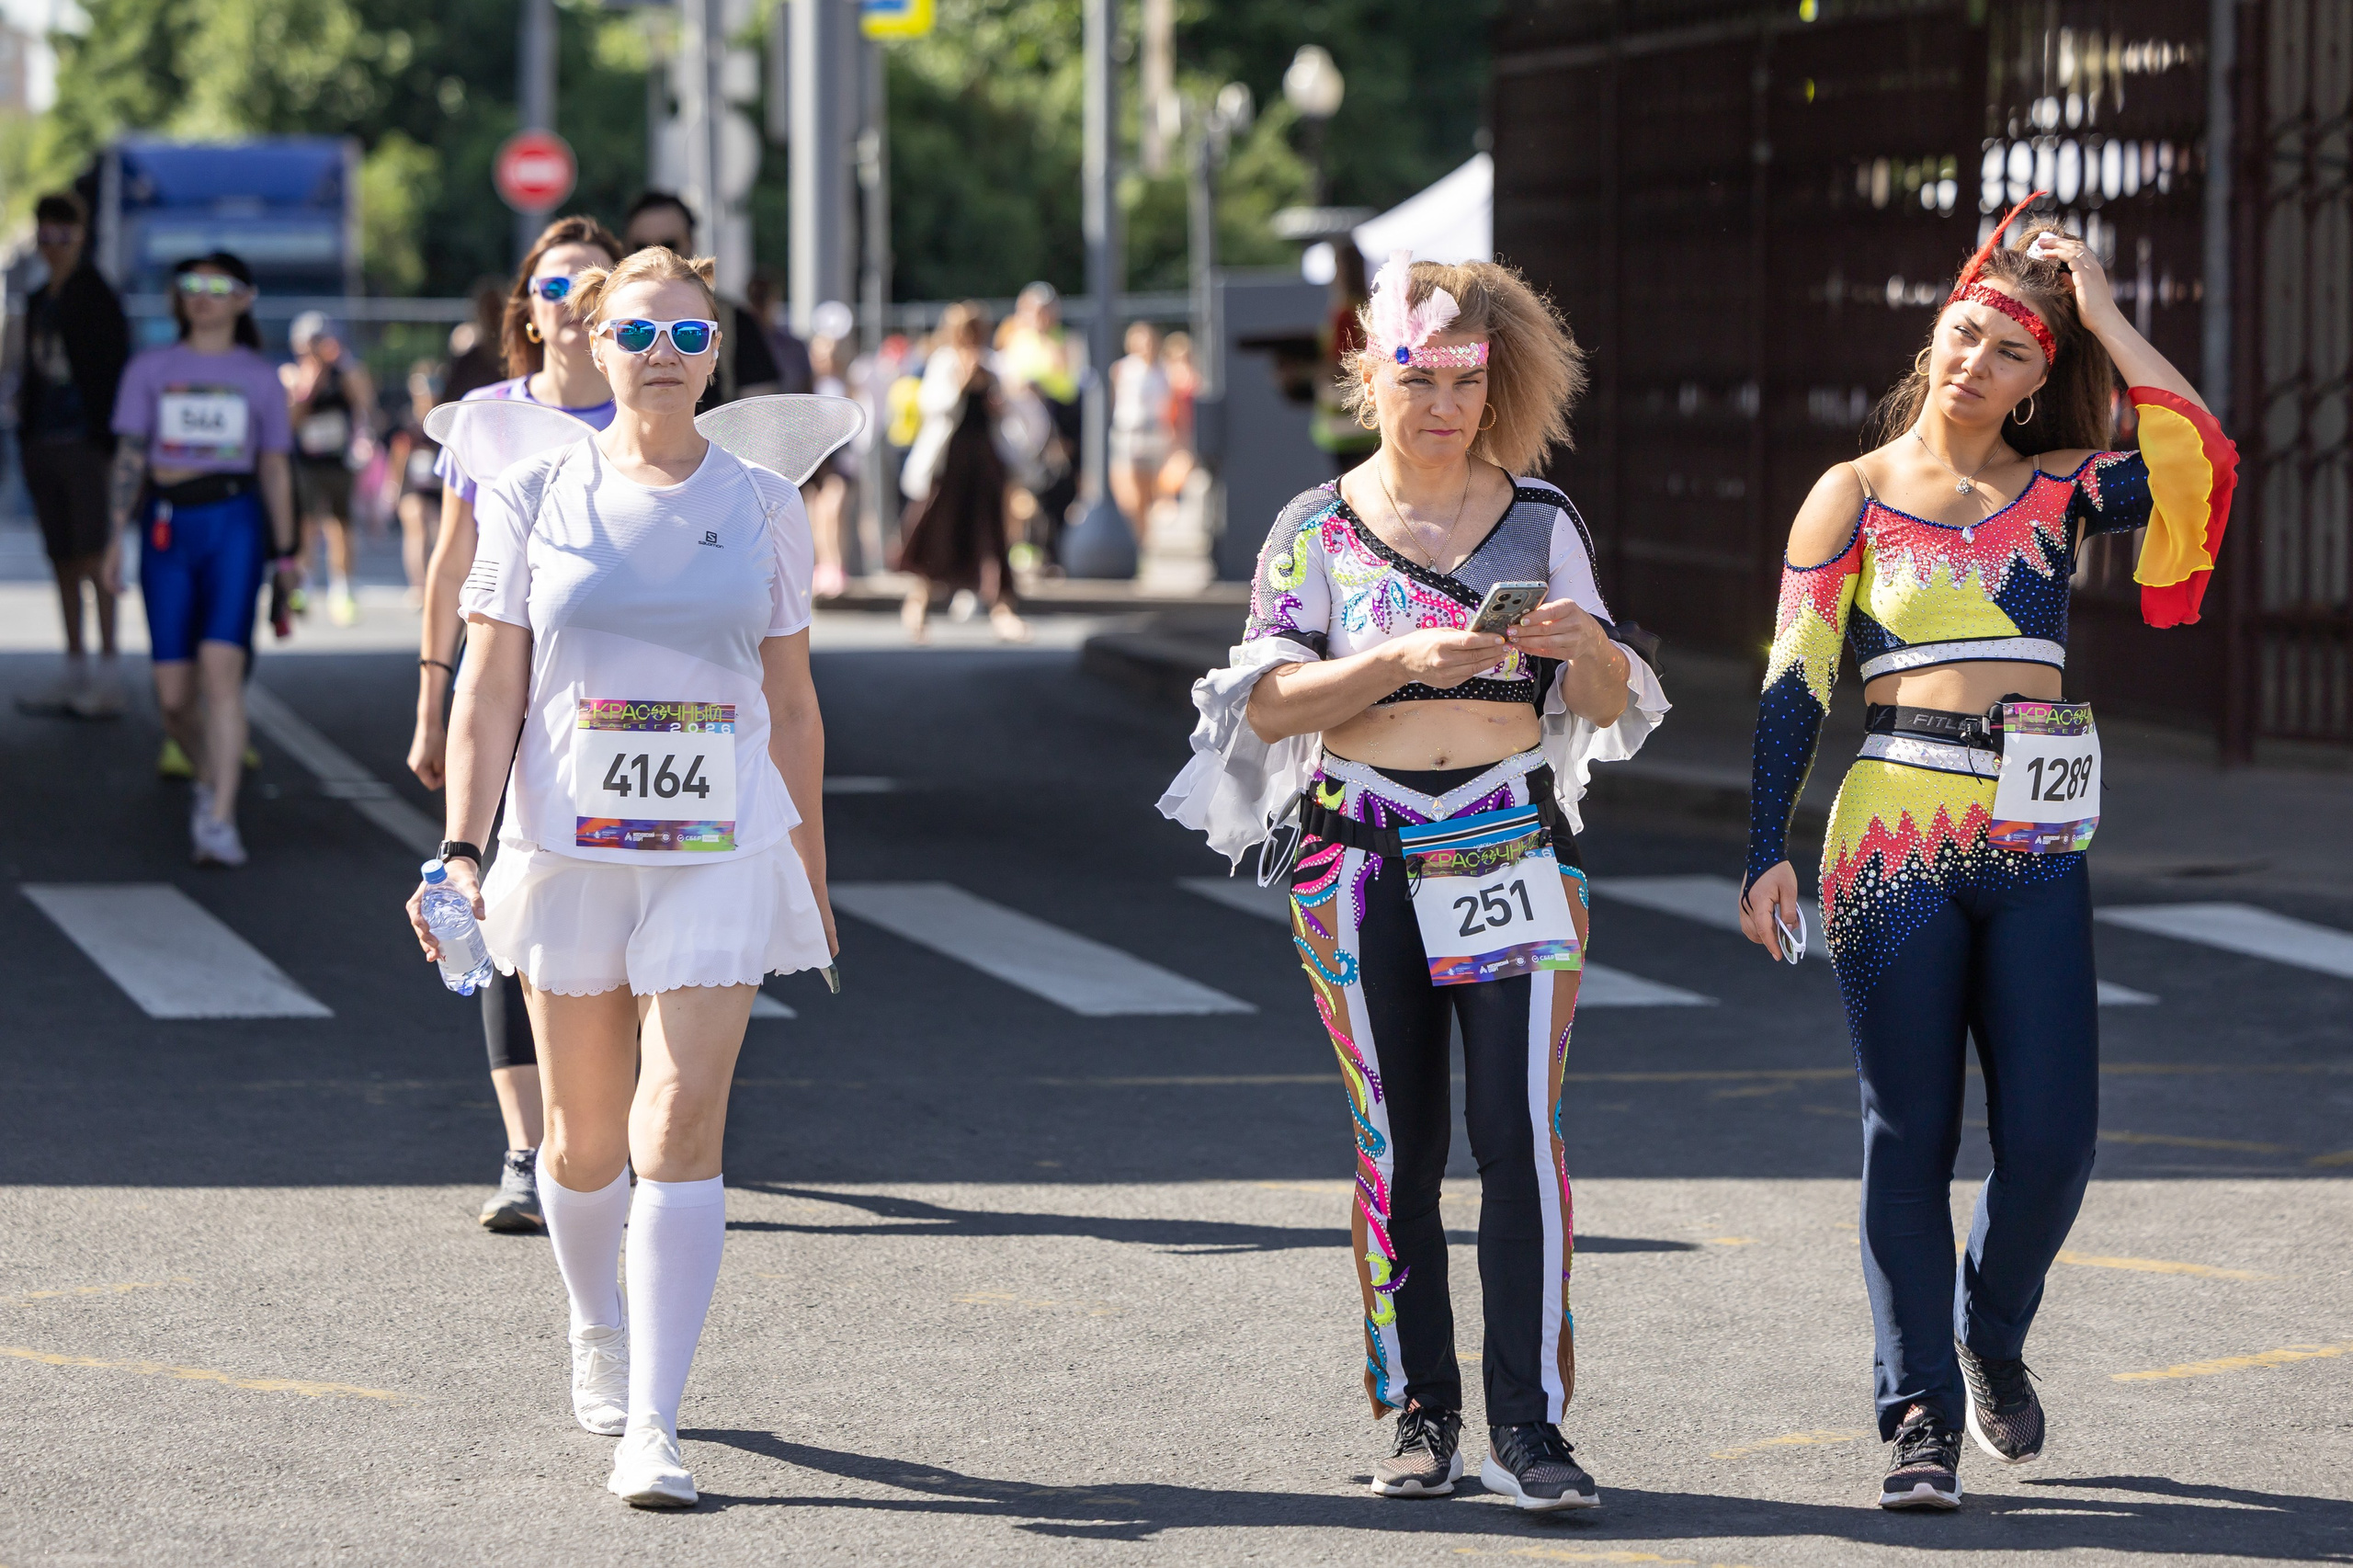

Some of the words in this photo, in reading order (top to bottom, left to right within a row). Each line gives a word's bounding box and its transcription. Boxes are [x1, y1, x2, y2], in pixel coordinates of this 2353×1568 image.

[593, 702, 722, 722] КРАСОЧНЫЙ
[670, 722, 731, 733] 2026
[603, 754, 710, 799] 4164
[2028, 755, 2092, 801] 1289
[1453, 880, 1534, 937] 251
